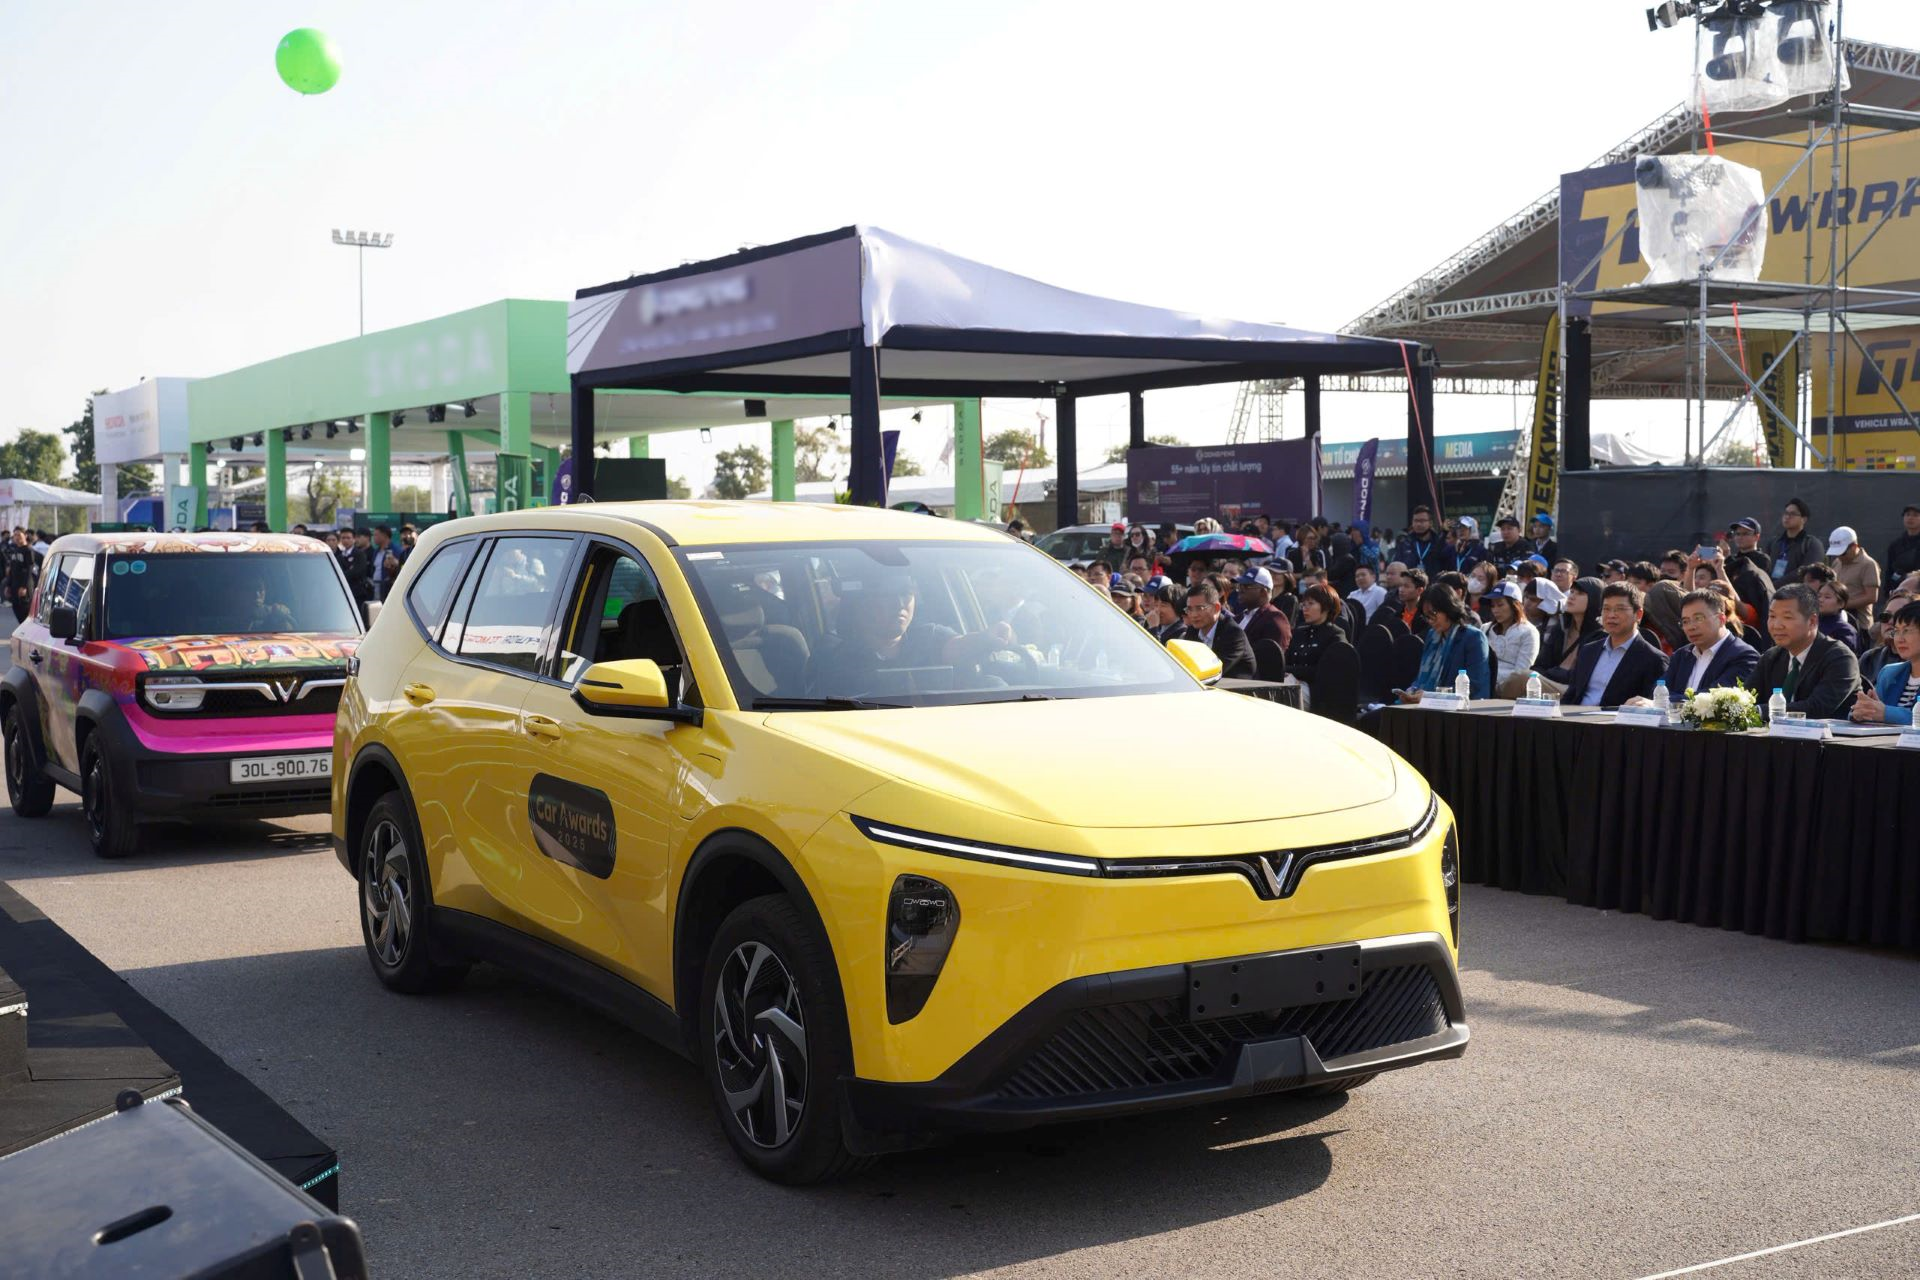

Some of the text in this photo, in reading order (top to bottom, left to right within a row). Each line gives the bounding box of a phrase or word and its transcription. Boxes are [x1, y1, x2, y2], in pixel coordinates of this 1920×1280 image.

[1854, 418, 1889, 429] VEHICLE
[1445, 440, 1474, 458] MEDIA
[241, 759, 328, 778] 30L-900.76
[536, 796, 607, 841] Car Awards
[558, 830, 585, 851] 2025
